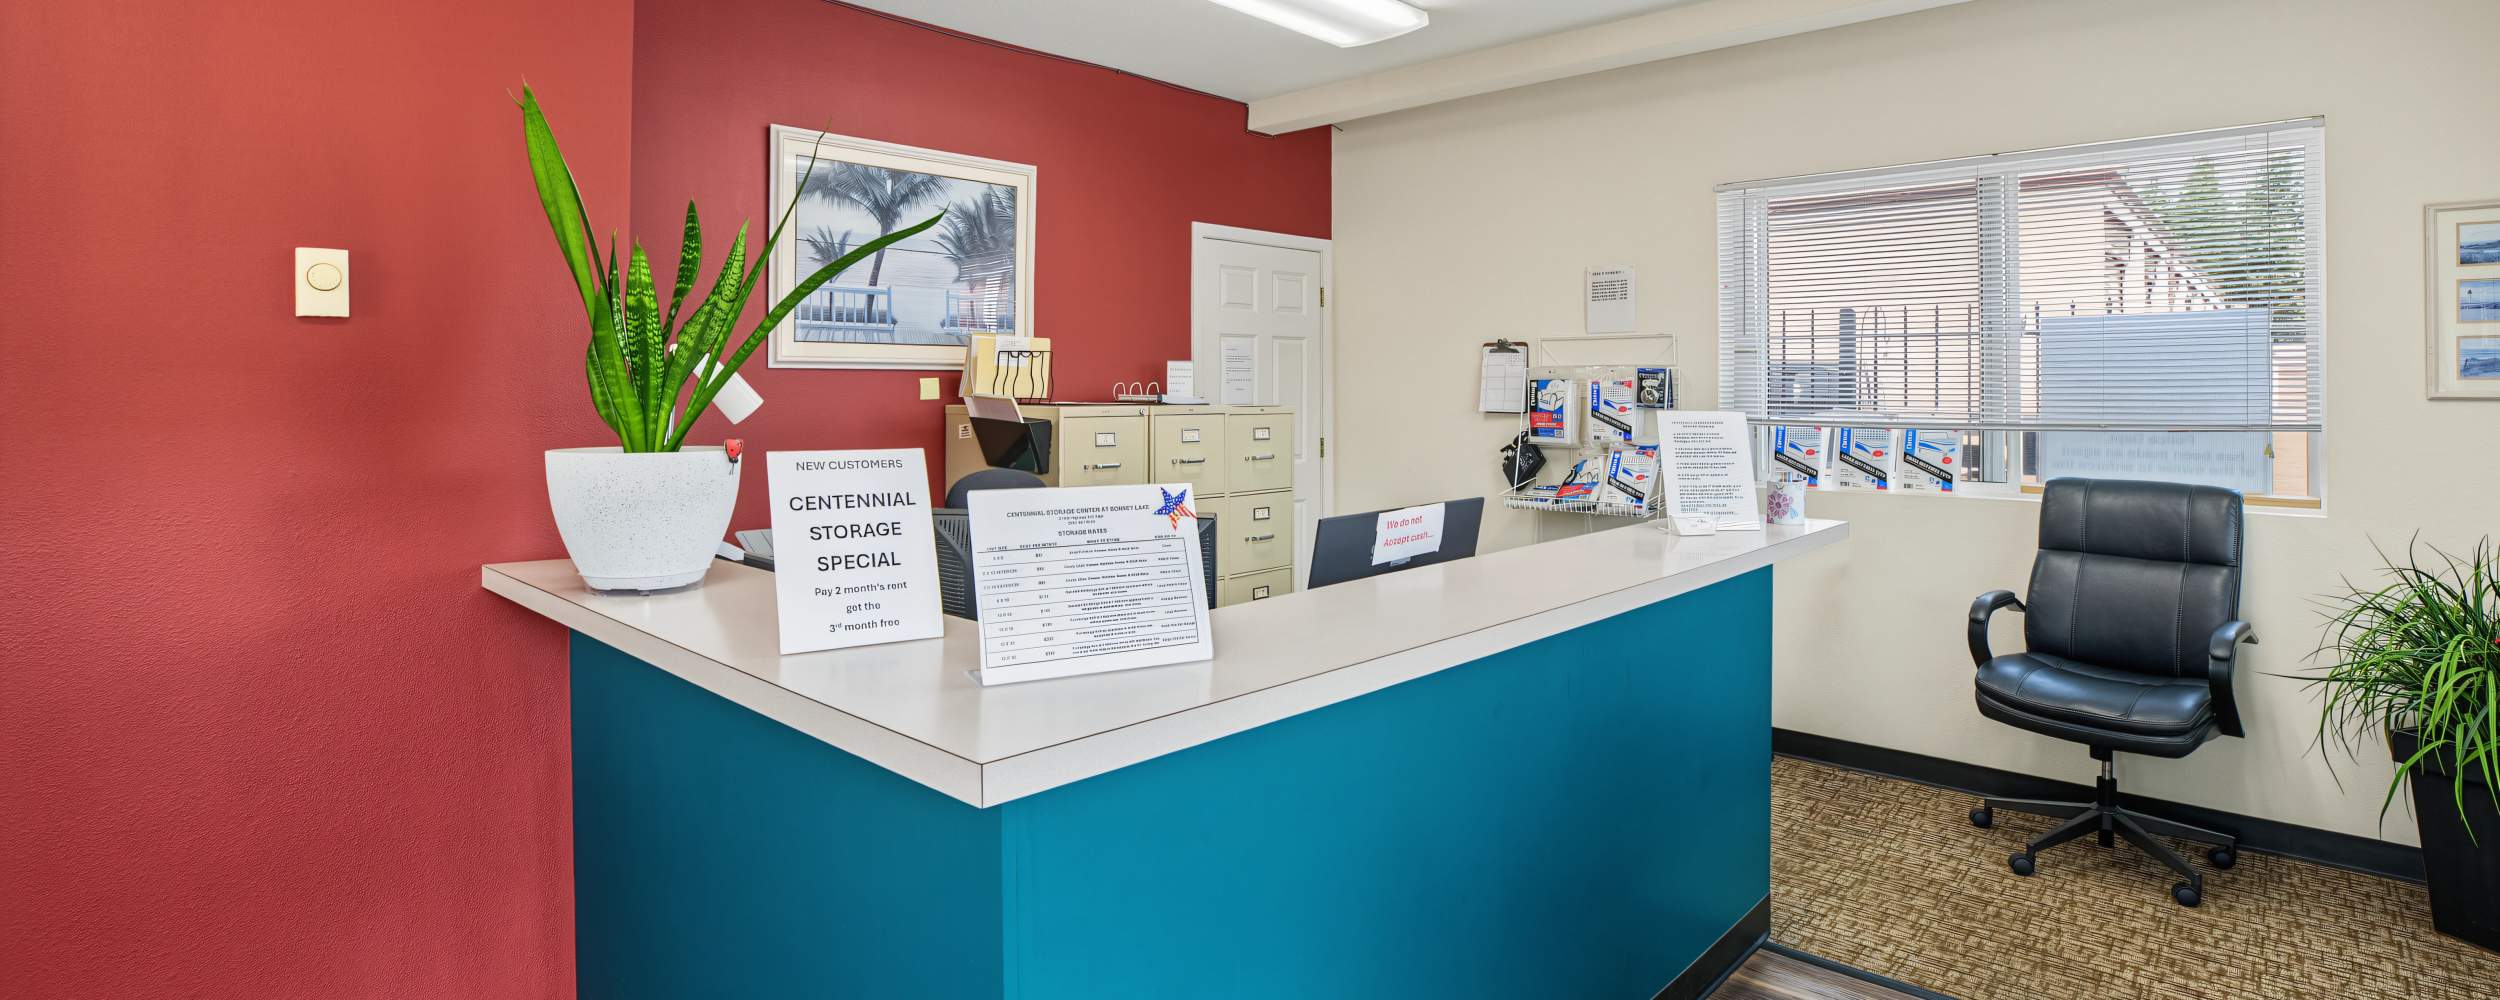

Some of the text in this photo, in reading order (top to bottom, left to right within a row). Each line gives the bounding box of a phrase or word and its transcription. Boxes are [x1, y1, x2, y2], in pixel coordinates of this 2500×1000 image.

[796, 459, 903, 471] NEW CUSTOMERS
[789, 491, 916, 511] CENTENNIAL
[1046, 507, 1075, 516] STORAGE
[1076, 506, 1100, 514] CENTER
[1386, 515, 1423, 529] We do not
[810, 521, 902, 541] STORAGE
[1058, 529, 1086, 537] STORAGE
[1383, 535, 1410, 547] Accept
[817, 551, 901, 572] SPECIAL
[815, 580, 907, 597] Pay 2 month's rent
[846, 601, 881, 614] get the
[829, 617, 900, 633] 3rd month free
